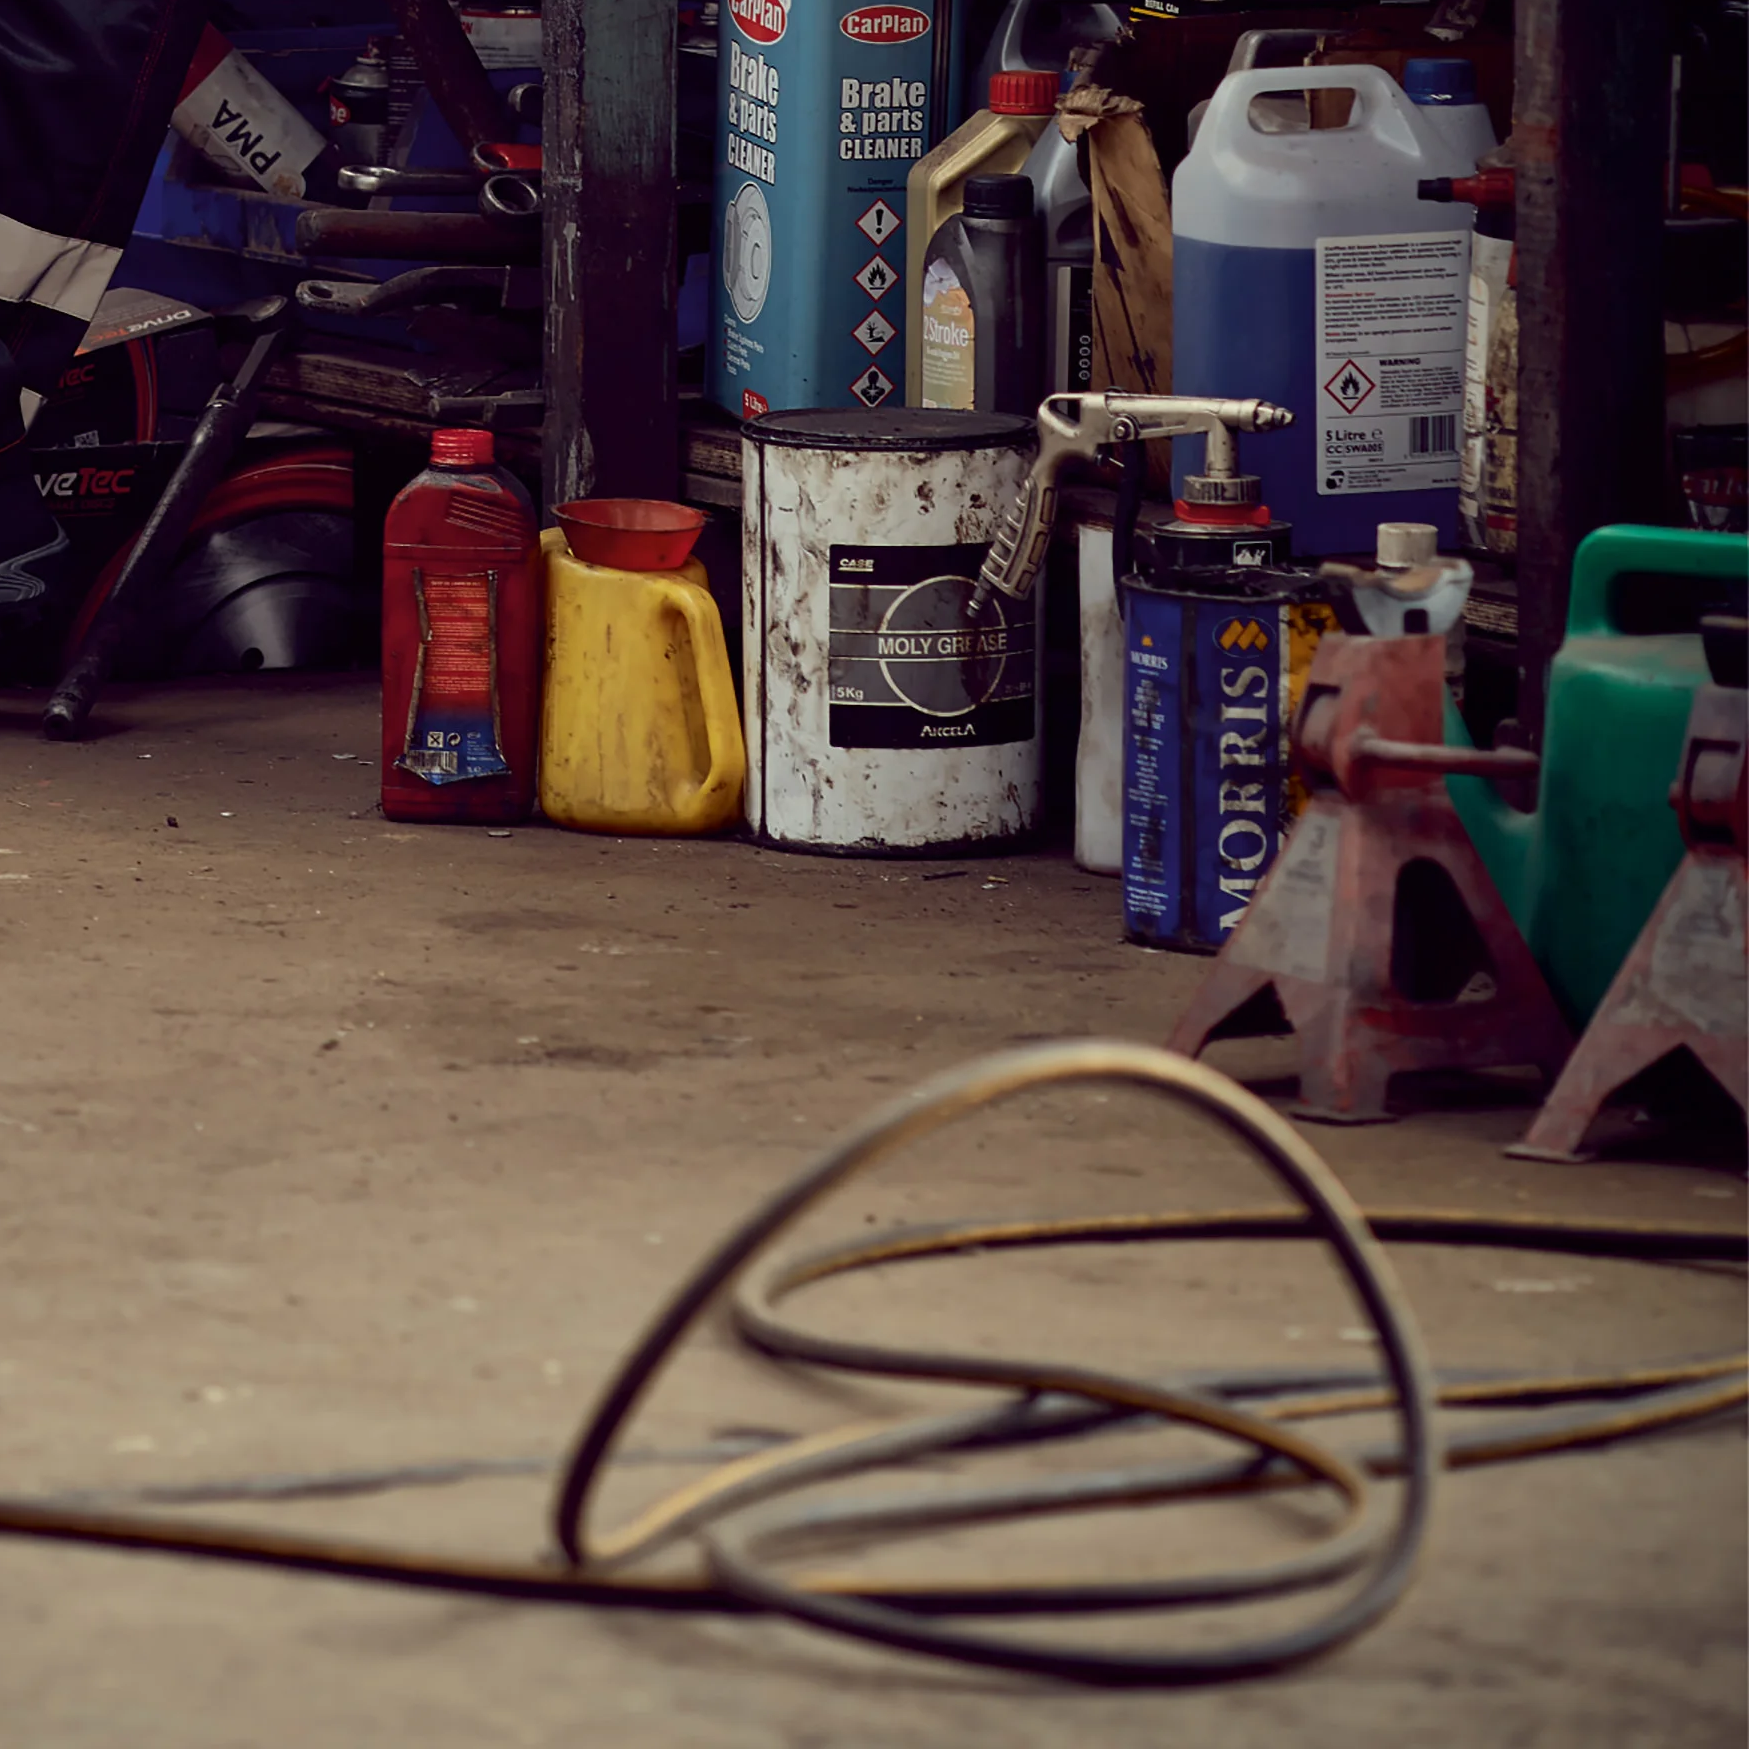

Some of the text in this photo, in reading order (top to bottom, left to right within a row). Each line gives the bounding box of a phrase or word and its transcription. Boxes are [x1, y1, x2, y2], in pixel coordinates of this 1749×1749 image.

[846, 14, 924, 34] CarPlan
[730, 39, 779, 108] Brake
[840, 76, 927, 110] Brake
[728, 91, 777, 144] & parts
[839, 109, 924, 136] & parts
[212, 99, 282, 175] PMA
[839, 137, 924, 160] CLEANER
[727, 130, 776, 186] CLEANER
[1379, 357, 1421, 367] WARNING
[1326, 430, 1333, 442] 5
[1335, 429, 1366, 441] Litre
[1326, 444, 1343, 454] CC
[839, 558, 875, 568] CASE
[878, 633, 1008, 655] MOLY GREASE
[1130, 650, 1169, 670] MORRIS
[1218, 665, 1270, 932] MORRIS
